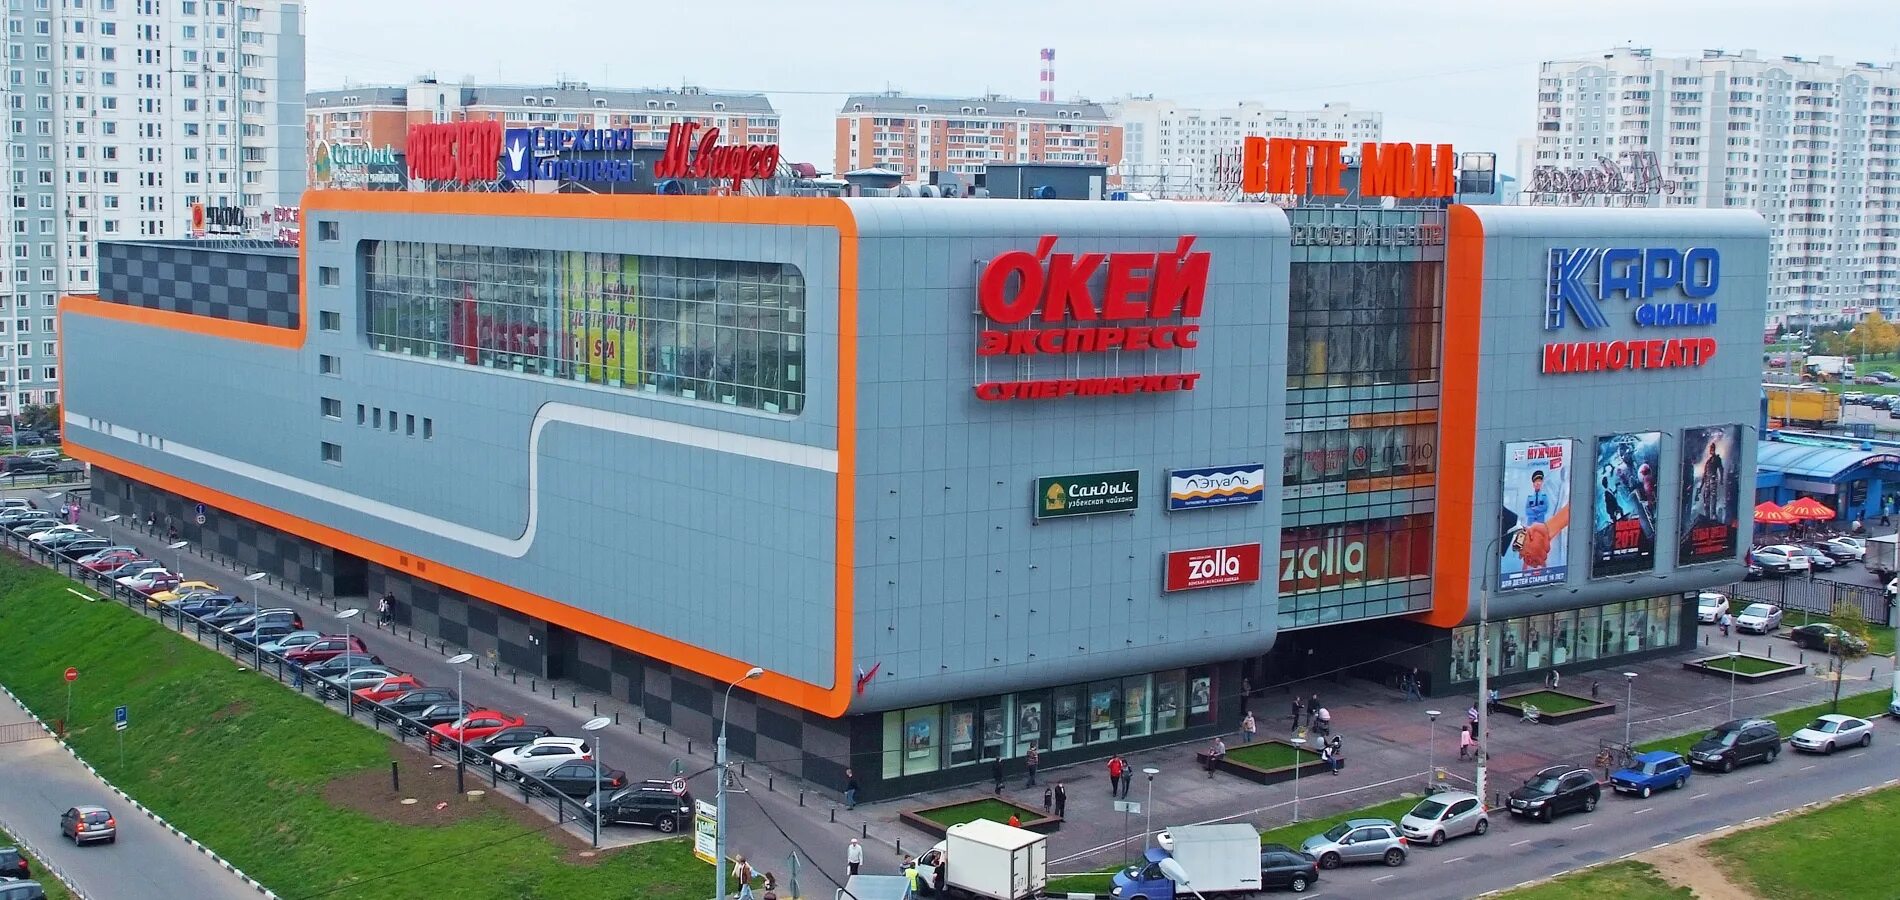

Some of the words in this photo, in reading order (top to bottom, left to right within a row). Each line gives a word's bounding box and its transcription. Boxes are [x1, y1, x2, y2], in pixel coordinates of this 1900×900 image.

[530, 127, 633, 152] Снежная
[332, 141, 398, 166] Сандык
[530, 157, 634, 183] Королева
[1244, 136, 1348, 196] ВИТТЕ
[1361, 142, 1456, 198] МОЛЛ
[1379, 223, 1445, 250] ЦЕНТР
[979, 235, 1212, 324] О'КЕЙ
[1545, 247, 1720, 331] КАРО
[1635, 303, 1717, 327] ФИЛЬМ
[976, 325, 1200, 357] ЭКСПРЕСС
[1543, 337, 1718, 374] КИНОТЕАТР
[976, 373, 1201, 401] СУПЕРМАРКЕТ
[1382, 442, 1433, 466] ПАТИО
[1527, 446, 1563, 460] МУЖЧИНА
[1068, 481, 1134, 498] Сандык
[1068, 499, 1104, 510] узбекская
[1105, 495, 1134, 505] чайхана
[1615, 530, 1641, 550] 2017
[1188, 548, 1240, 580] zolla
[1280, 526, 1365, 582] zolla
[1512, 578, 1528, 586] ДЕТЕЙ
[1529, 574, 1549, 584] СТАРШЕ
[117, 708, 125, 721] P
